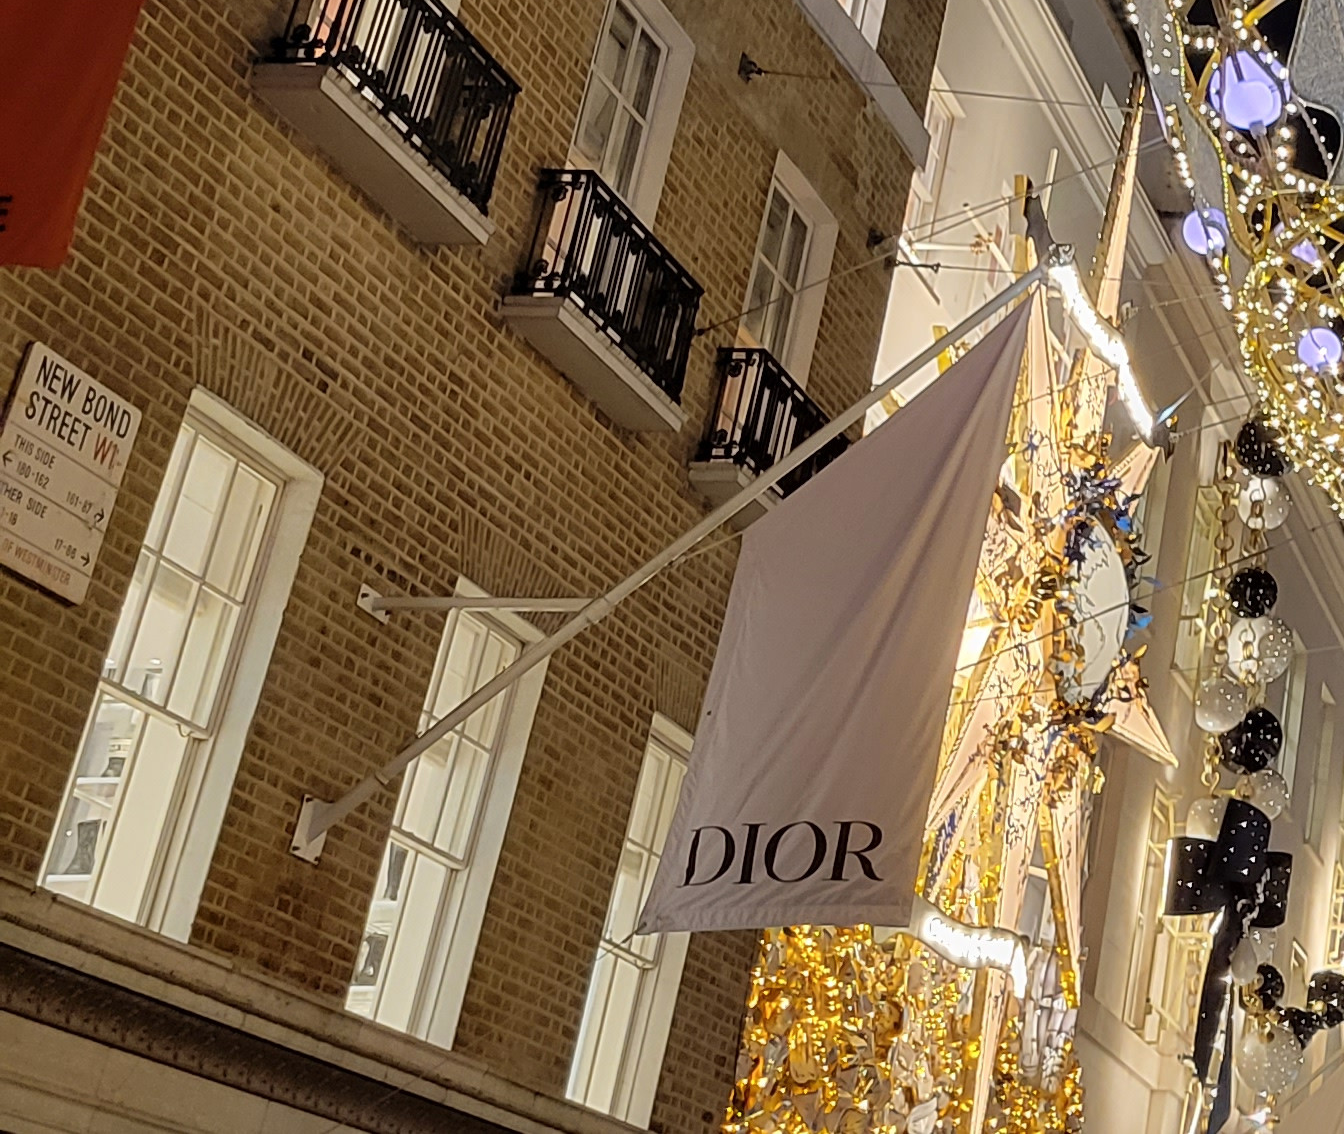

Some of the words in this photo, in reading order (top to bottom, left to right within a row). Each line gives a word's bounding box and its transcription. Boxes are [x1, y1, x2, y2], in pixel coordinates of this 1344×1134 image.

[25, 390, 92, 452] STREET
[36, 355, 82, 404] NEW
[82, 385, 132, 439] BOND
[14, 434, 35, 457] THIS
[34, 447, 56, 470] SIDE
[26, 497, 48, 520] SIDE
[15, 544, 71, 585] WESTMINSTER
[676, 820, 884, 888] DIOR
